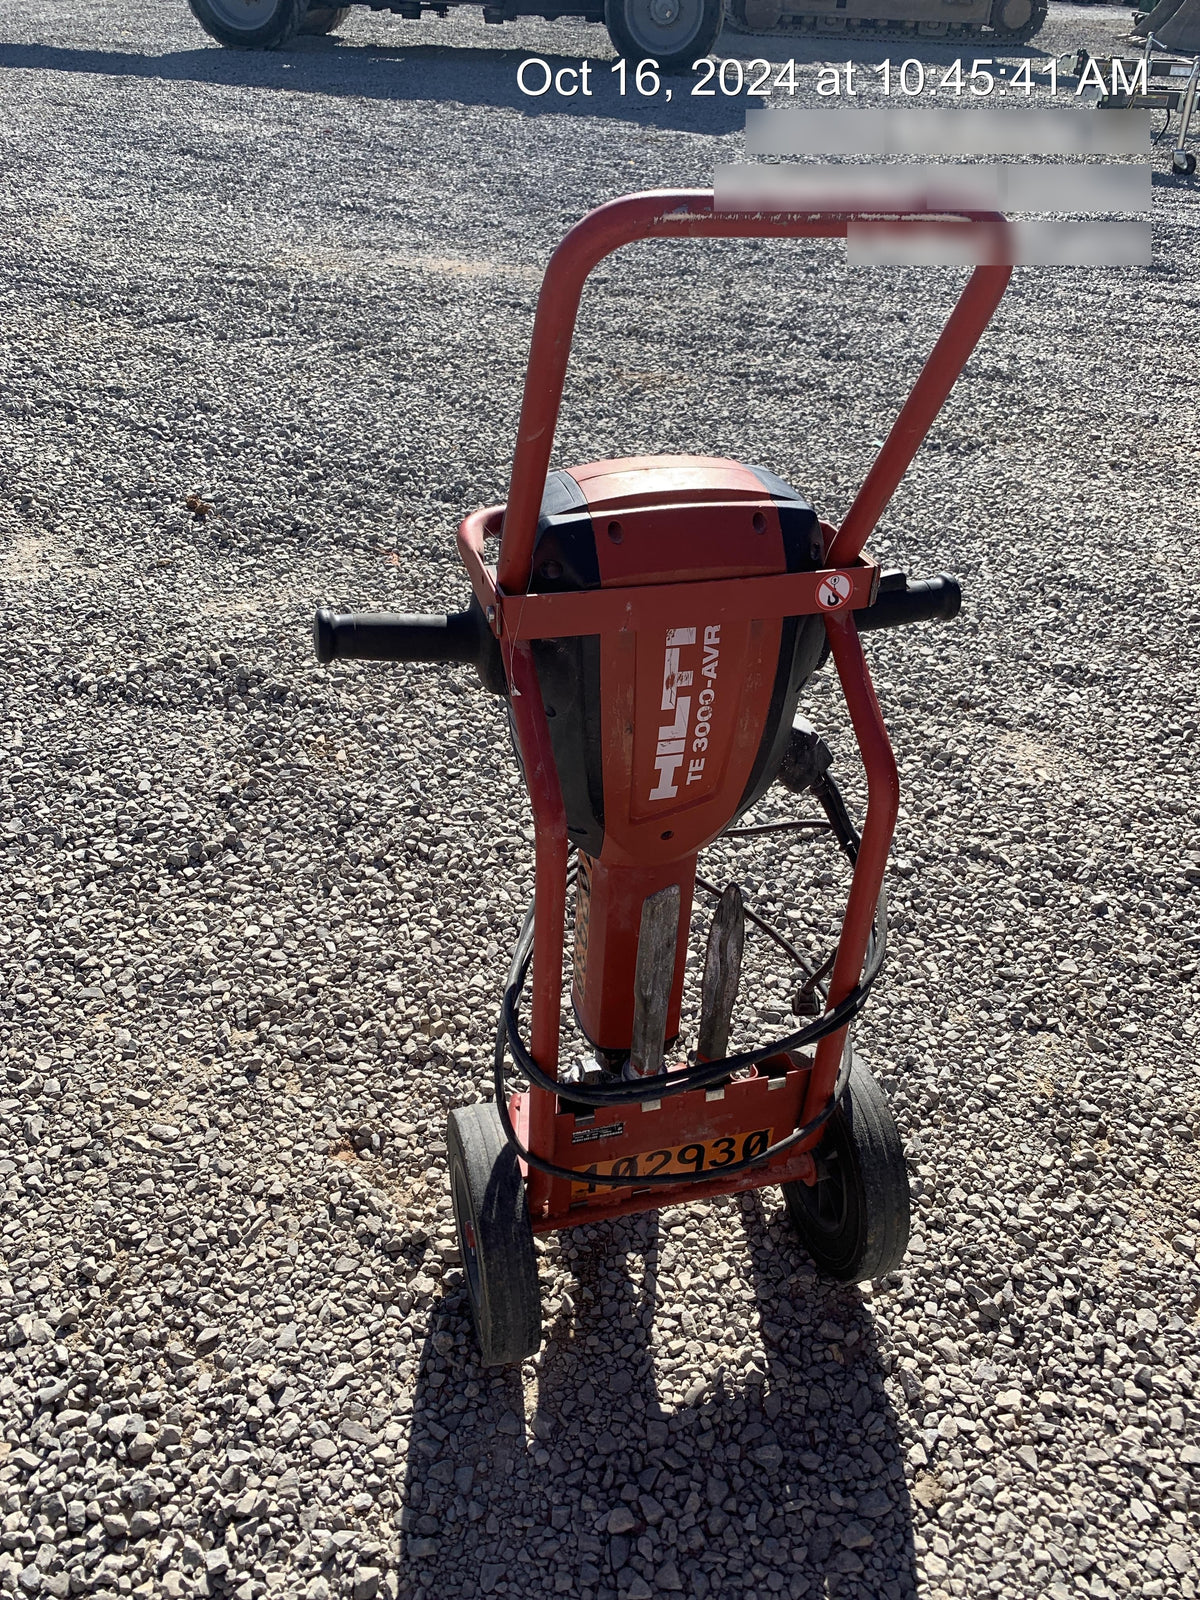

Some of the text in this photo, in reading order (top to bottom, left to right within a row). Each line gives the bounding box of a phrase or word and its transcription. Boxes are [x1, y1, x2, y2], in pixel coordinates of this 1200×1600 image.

[648, 626, 697, 801] HILTI
[686, 624, 721, 786] TE 3000-AVR
